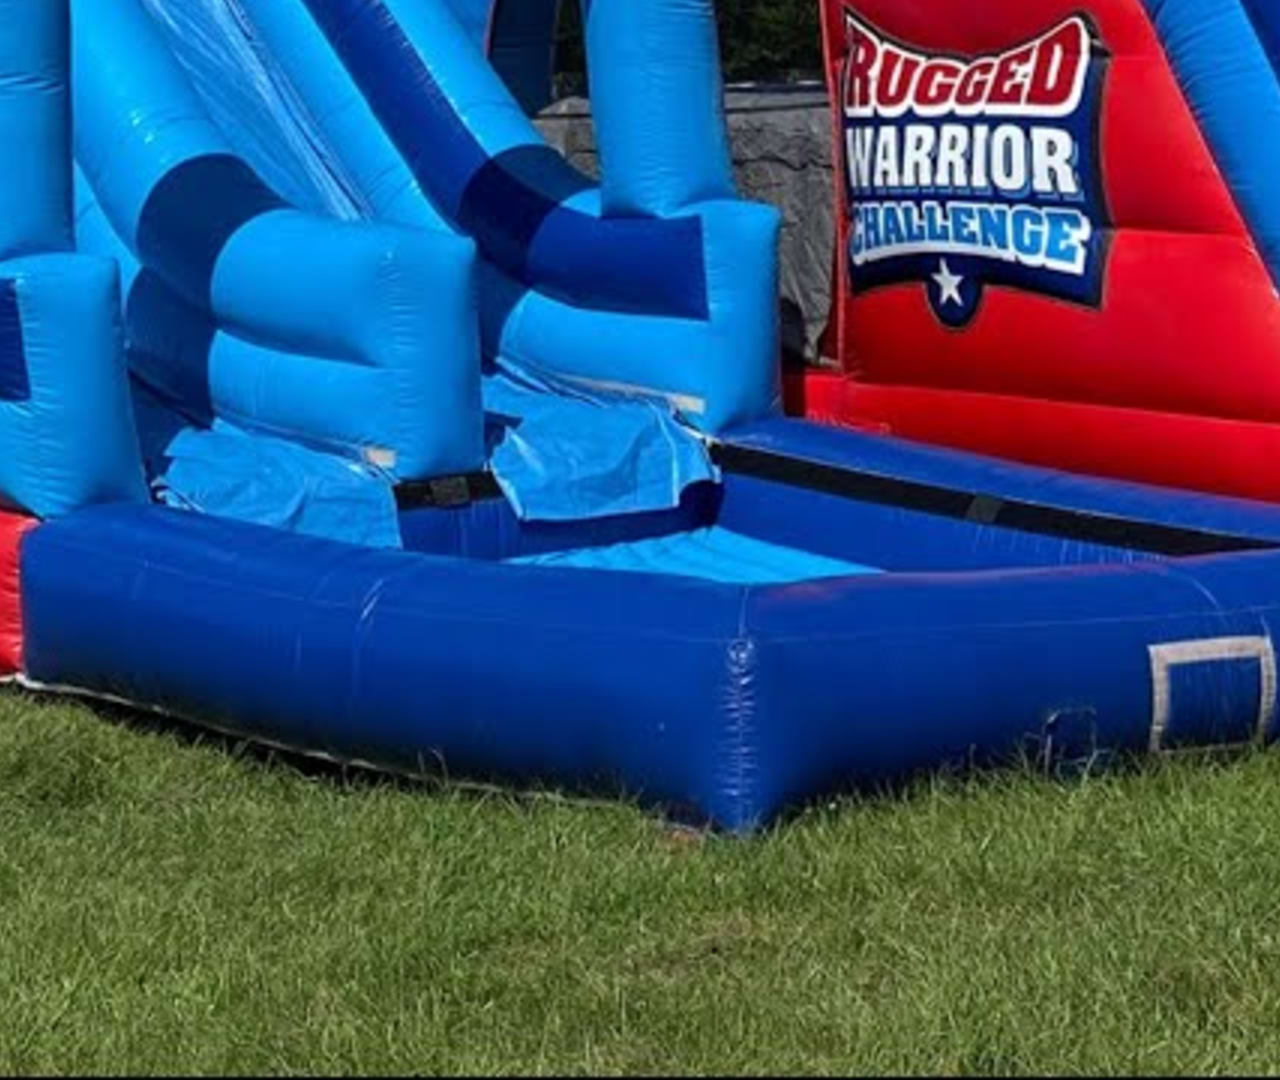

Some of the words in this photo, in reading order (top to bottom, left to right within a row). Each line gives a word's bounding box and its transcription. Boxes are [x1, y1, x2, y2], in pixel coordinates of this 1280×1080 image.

[845, 16, 1089, 116] RUGGED
[845, 123, 1080, 196] WARRIOR
[849, 202, 1091, 274] CHALLENGE
